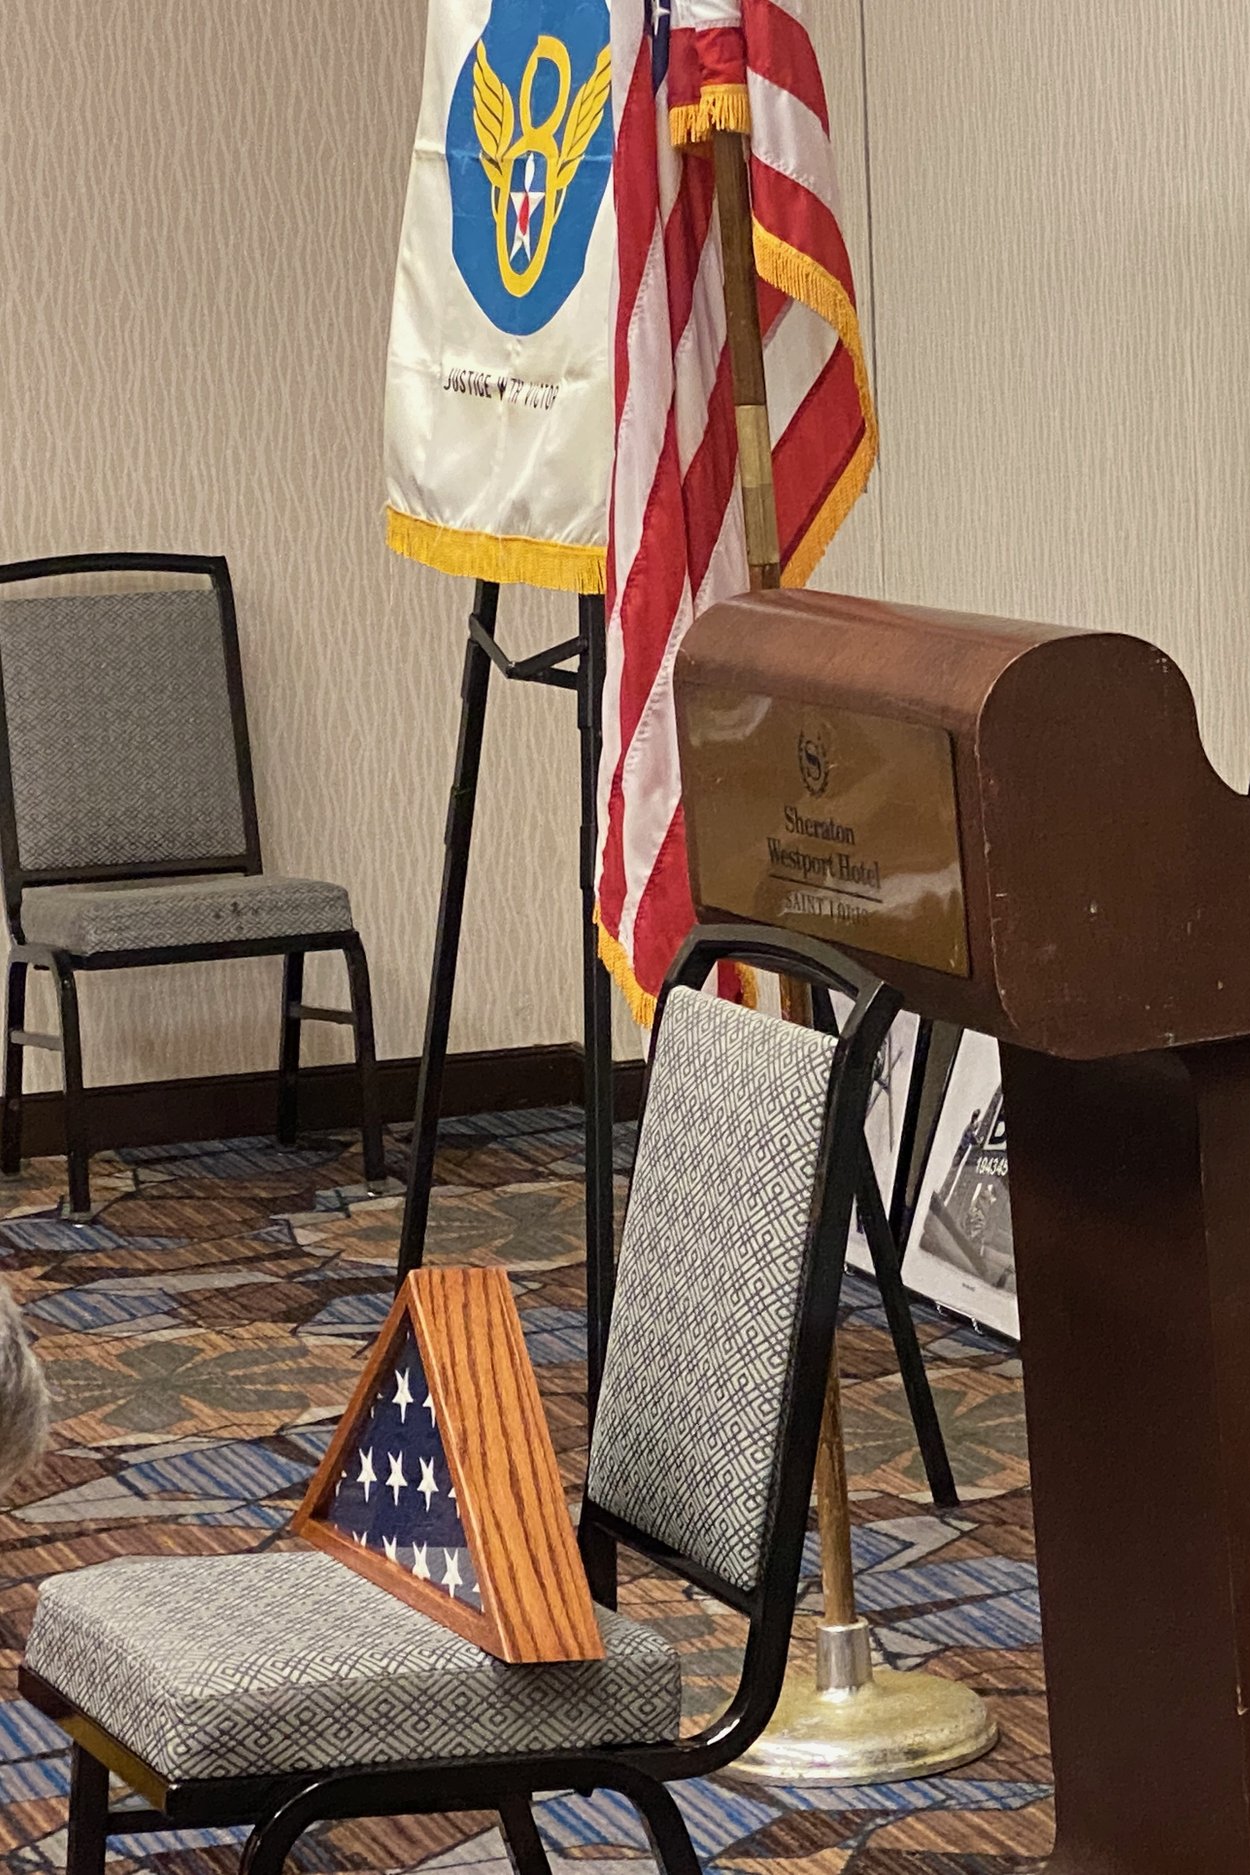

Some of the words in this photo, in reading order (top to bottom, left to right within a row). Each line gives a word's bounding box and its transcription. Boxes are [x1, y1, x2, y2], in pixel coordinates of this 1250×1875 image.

[443, 367, 492, 399] JUSTICE
[784, 805, 855, 845] Sheraton
[766, 837, 835, 879] Westport
[836, 853, 881, 890] Hotel
[785, 890, 824, 916] SAINT
